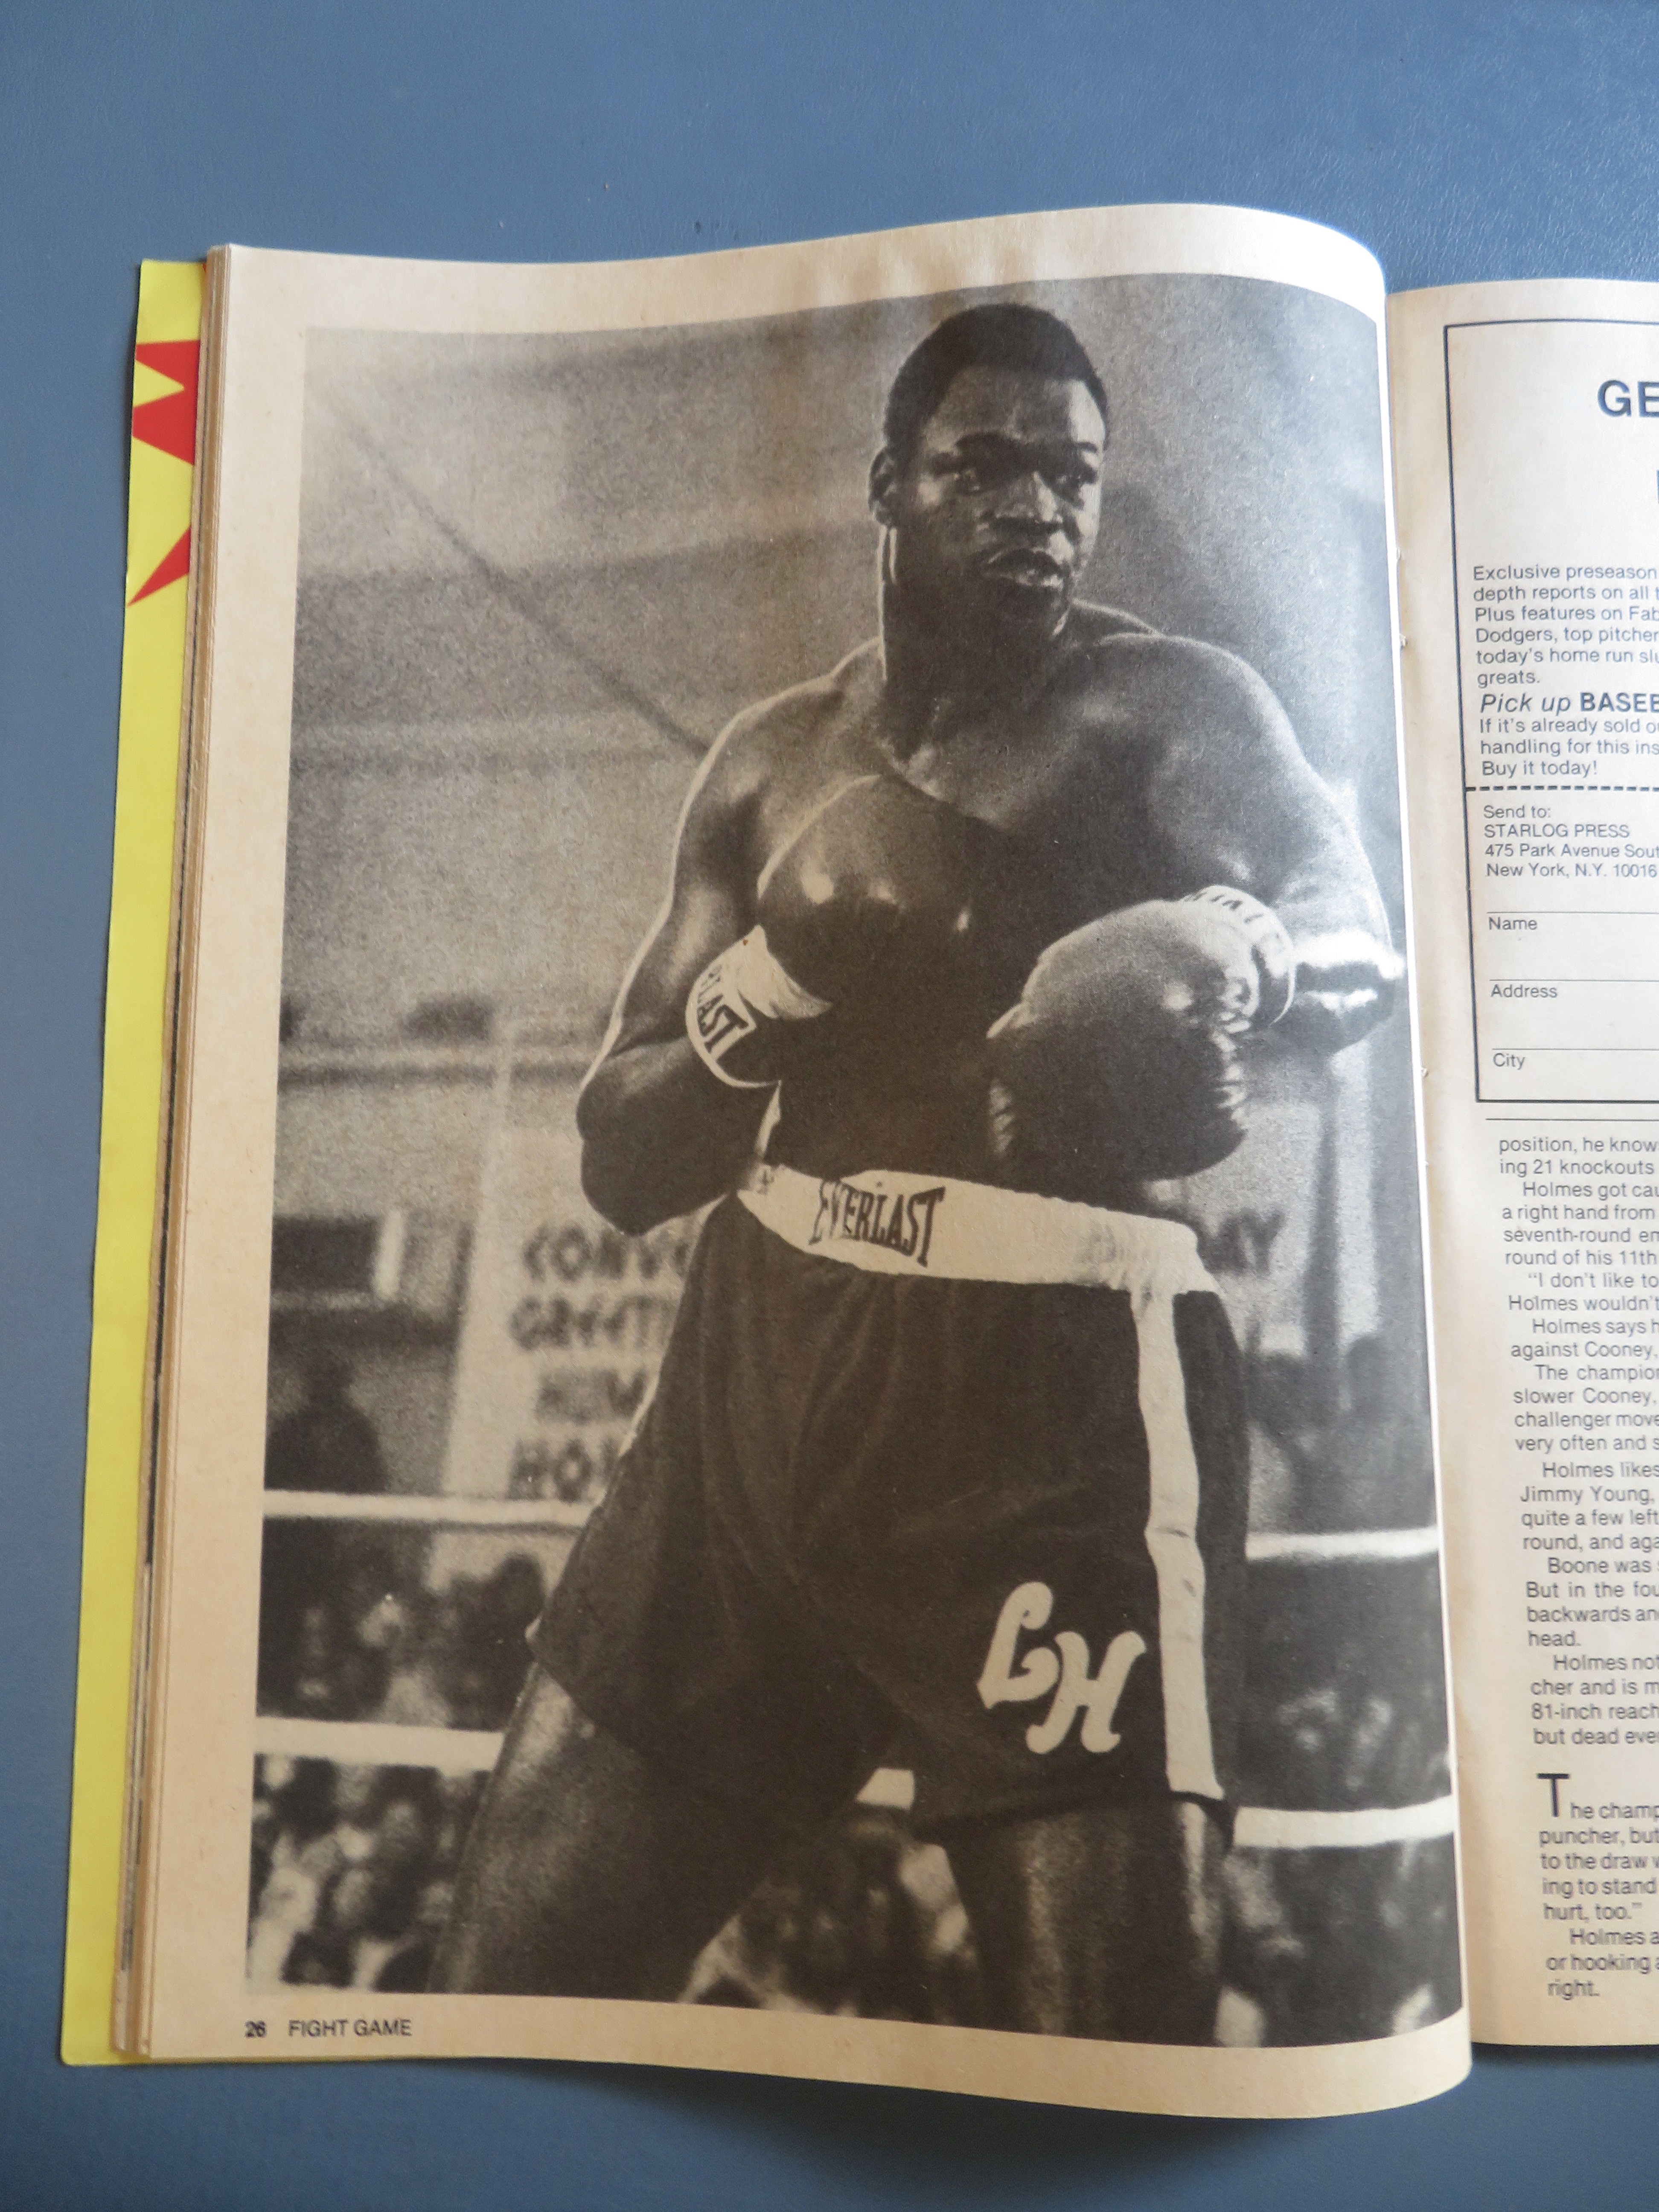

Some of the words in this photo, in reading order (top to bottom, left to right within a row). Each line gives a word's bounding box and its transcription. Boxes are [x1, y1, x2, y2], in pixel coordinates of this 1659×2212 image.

[1473, 564, 1560, 581] Exclusive
[1566, 566, 1657, 582] preseason
[1473, 585, 1526, 604] depth
[1532, 585, 1596, 602] reports
[1601, 588, 1623, 600] on
[1629, 585, 1649, 600] all
[1475, 607, 1515, 622] Plus
[1521, 605, 1596, 620] features
[1601, 608, 1623, 620] on
[1476, 627, 1558, 646] Dodgers,
[1563, 627, 1593, 644] top
[1598, 626, 1659, 645] pitcher
[1476, 647, 1544, 666] today's
[1549, 647, 1600, 662] home
[1606, 650, 1634, 663] run
[1477, 670, 1540, 689] greats.
[1480, 693, 1533, 713] Pick
[1541, 697, 1571, 716] up
[1480, 718, 1491, 733] If
[1498, 718, 1526, 733] it's
[1531, 717, 1598, 736] already
[1603, 718, 1641, 733] sold
[1646, 722, 1659, 733] o
[1481, 739, 1561, 757] handling
[1566, 738, 1592, 754] for
[1596, 739, 1630, 754] this
[1635, 739, 1659, 755] ins
[1482, 760, 1517, 779] Buy
[1523, 760, 1534, 775] it
[1540, 760, 1597, 778] today!
[1484, 805, 1526, 819] Send
[1531, 805, 1551, 818] to:
[1484, 823, 1569, 838] STARLOG
[1574, 824, 1630, 838] PRESS
[1485, 843, 1514, 857] 475
[1519, 843, 1555, 857] Park
[1560, 843, 1620, 858] Avenue
[1487, 863, 1524, 876] New
[1528, 862, 1569, 879] York,
[1575, 863, 1607, 876] N.Y.
[1613, 863, 1658, 878] 10016
[1489, 917, 1537, 930] Name
[1490, 984, 1558, 998] Address
[1493, 1053, 1525, 1070] City
[1499, 1136, 1578, 1155] position,
[1583, 1137, 1604, 1152] he
[1610, 1137, 1659, 1152] know
[1500, 1158, 1528, 1178] ing
[1533, 1159, 1551, 1174] 21
[1560, 1159, 1655, 1175] knockouts
[1523, 1181, 1593, 1197] Holmes
[1598, 1183, 1627, 1201] got
[1502, 1208, 1513, 1220] a
[1517, 1204, 1559, 1223] right
[1563, 1204, 1609, 1220] hand
[1613, 1204, 1656, 1220] from
[808, 1179, 946, 1268] EVERLAST
[1504, 1226, 1631, 1243] seventh-round
[1505, 1249, 1557, 1265] round
[1562, 1249, 1580, 1265] of
[1586, 1250, 1613, 1265] his
[1619, 1250, 1658, 1265] 11th
[1550, 1272, 1596, 1288] don't
[1603, 1272, 1635, 1288] like
[1508, 1295, 1578, 1311] Holmes
[1532, 1318, 1601, 1334] Holmes
[1605, 1321, 1647, 1338] says
[1511, 1342, 1579, 1361] against
[1534, 1364, 1569, 1380] The
[1576, 1364, 1659, 1383] champio
[1513, 1388, 1575, 1404] slower
[1514, 1411, 1612, 1431] challenger
[1515, 1438, 1554, 1455] very
[1560, 1434, 1607, 1451] often
[1613, 1435, 1647, 1450] and
[1543, 1462, 1614, 1478] Holmes
[1520, 1486, 1583, 1505] Jimmy
[1521, 1510, 1570, 1529] quite
[1575, 1513, 1587, 1525] a
[1591, 1509, 1624, 1526] few
[1523, 1534, 1583, 1553] round,
[1589, 1534, 1624, 1550] and
[1548, 1557, 1609, 1574] Boone
[1614, 1560, 1652, 1573] was
[1526, 1581, 1560, 1598] But
[1568, 1581, 1586, 1598] in
[1594, 1582, 1625, 1598] the
[1527, 1606, 1631, 1623] backwards
[1528, 1630, 1581, 1647] head.
[1553, 1654, 1628, 1671] Holmes
[1530, 1679, 1574, 1696] cher
[1580, 1679, 1616, 1695] and
[1621, 1679, 1639, 1695] is
[1531, 1702, 1602, 1720] 81-inch
[1533, 1728, 1566, 1745] but
[1571, 1727, 1620, 1745] dead
[1624, 1731, 1659, 1744] eve
[1539, 1827, 1625, 1848] puncher,
[1540, 1853, 1562, 1869] to
[1564, 1852, 1597, 1870] the
[1600, 1852, 1649, 1869] draw
[1542, 1877, 1575, 1899] ing
[1577, 1878, 1598, 1895] to
[1601, 1877, 1657, 1895] stand
[1569, 1928, 1647, 1945] Holmes
[1545, 1957, 1568, 1971] or
[1570, 1953, 1652, 1975] hooking
[1548, 1978, 1600, 2001] right.
[245, 2020, 267, 2038] 26
[288, 2018, 349, 2038] FIGHT
[353, 2017, 412, 2037] GAME
